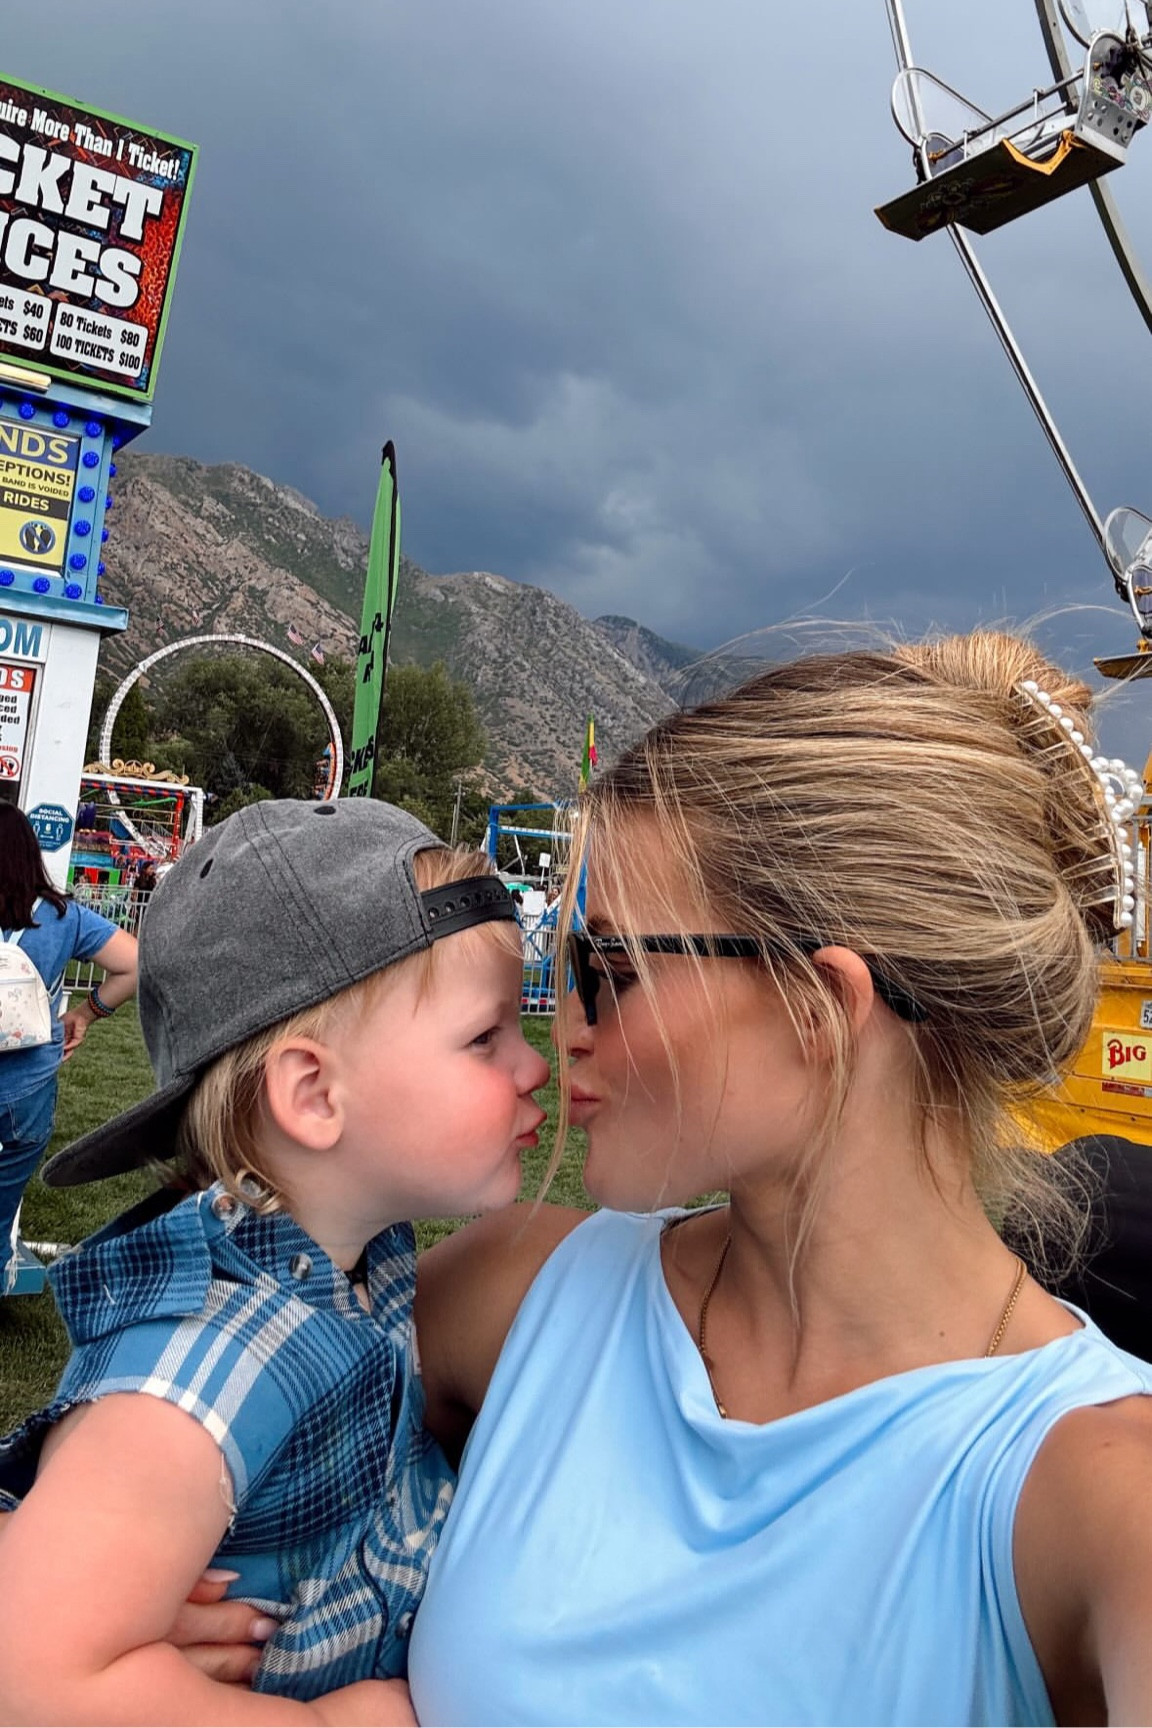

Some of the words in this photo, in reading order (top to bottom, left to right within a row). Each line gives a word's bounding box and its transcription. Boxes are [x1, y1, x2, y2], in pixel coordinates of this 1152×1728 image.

[30, 107, 71, 142] More
[74, 122, 114, 158] Than
[128, 142, 180, 181] Ticket!
[23, 299, 44, 319] $40
[23, 324, 44, 343] $60
[60, 311, 74, 328] 80
[76, 315, 112, 339] Tickets
[120, 328, 140, 348] $80
[56, 333, 73, 351] 100
[75, 338, 115, 363] TICKETS
[118, 351, 141, 370] $100
[0, 425, 69, 464] NDS
[2, 476, 26, 487] BAND
[28, 482, 37, 490] IS
[38, 484, 69, 497] VOIDED
[3, 490, 50, 511] RIDES
[30, 813, 70, 823] DISTANCING
[39, 808, 63, 816] SOCIAL
